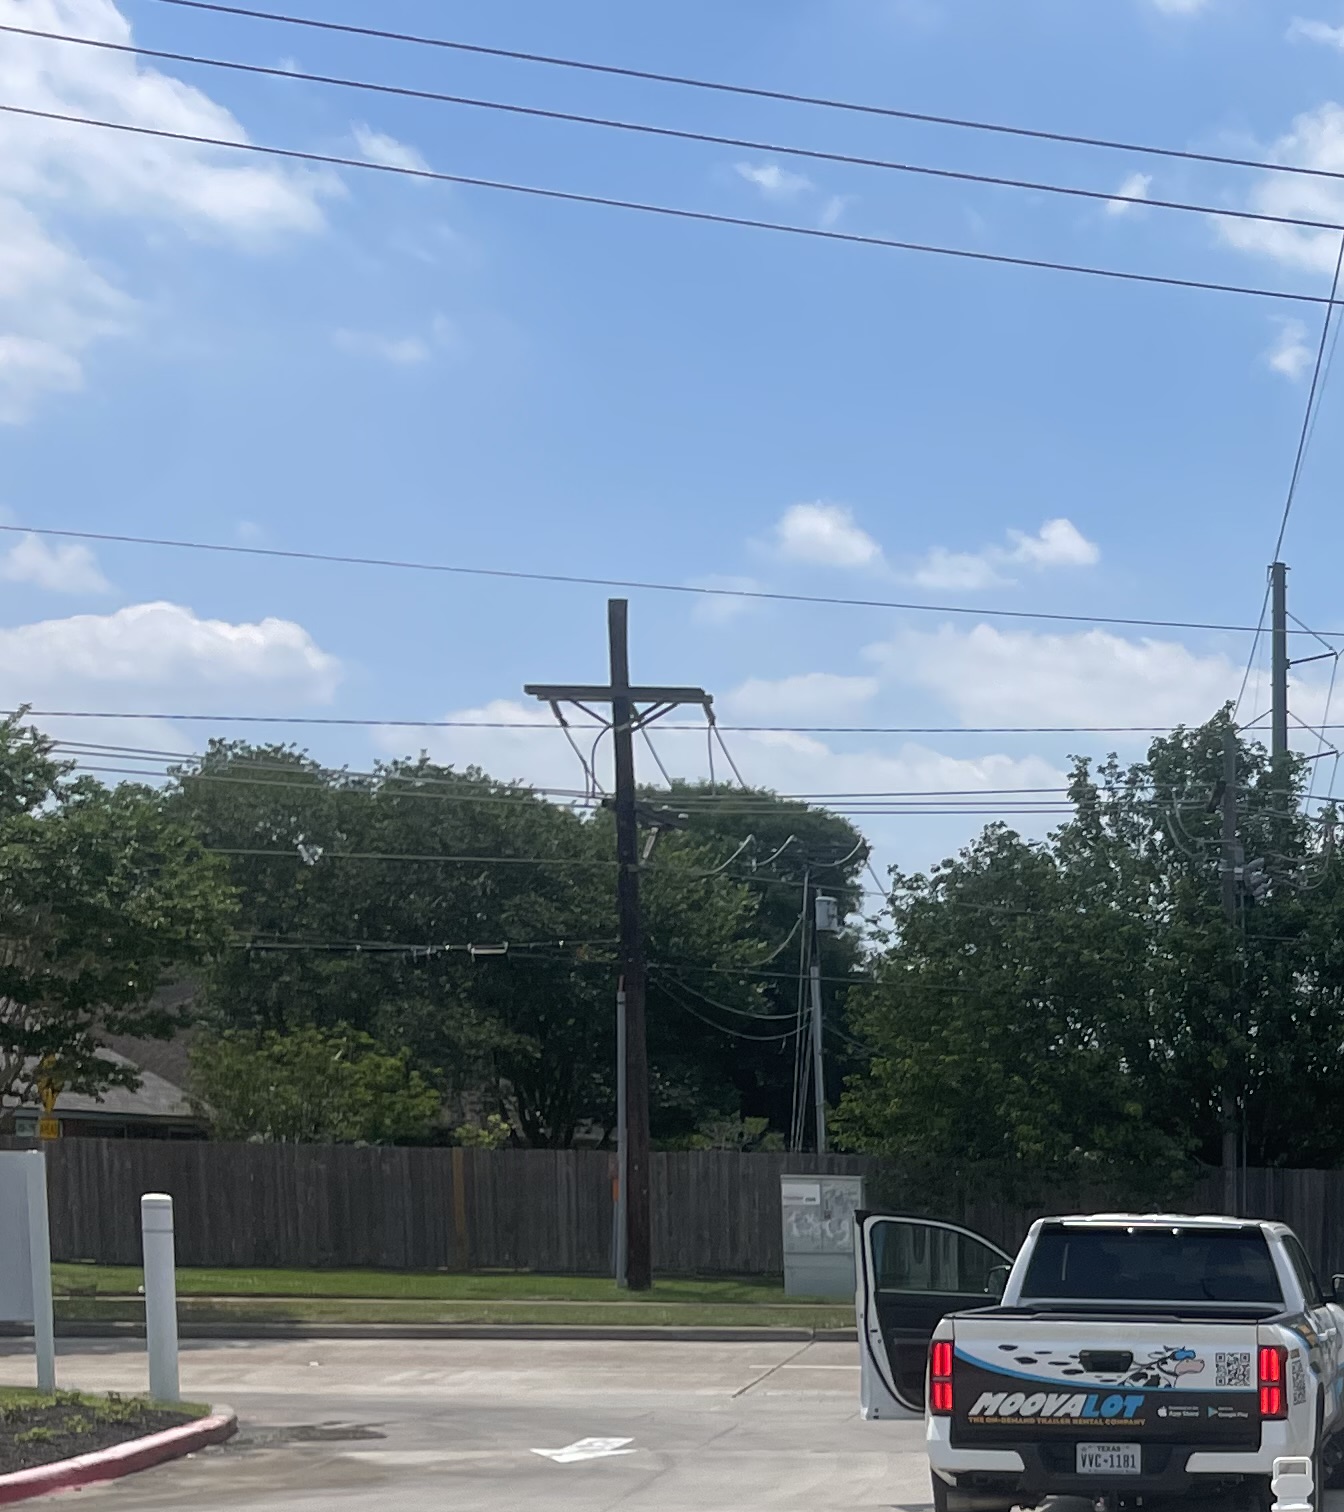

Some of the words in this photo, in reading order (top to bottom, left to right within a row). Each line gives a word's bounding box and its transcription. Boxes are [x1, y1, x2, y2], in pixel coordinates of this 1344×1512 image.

[968, 1392, 1145, 1418] MOOVALOT
[1072, 1418, 1103, 1426] RENTAL
[1104, 1418, 1146, 1427] COMPANY
